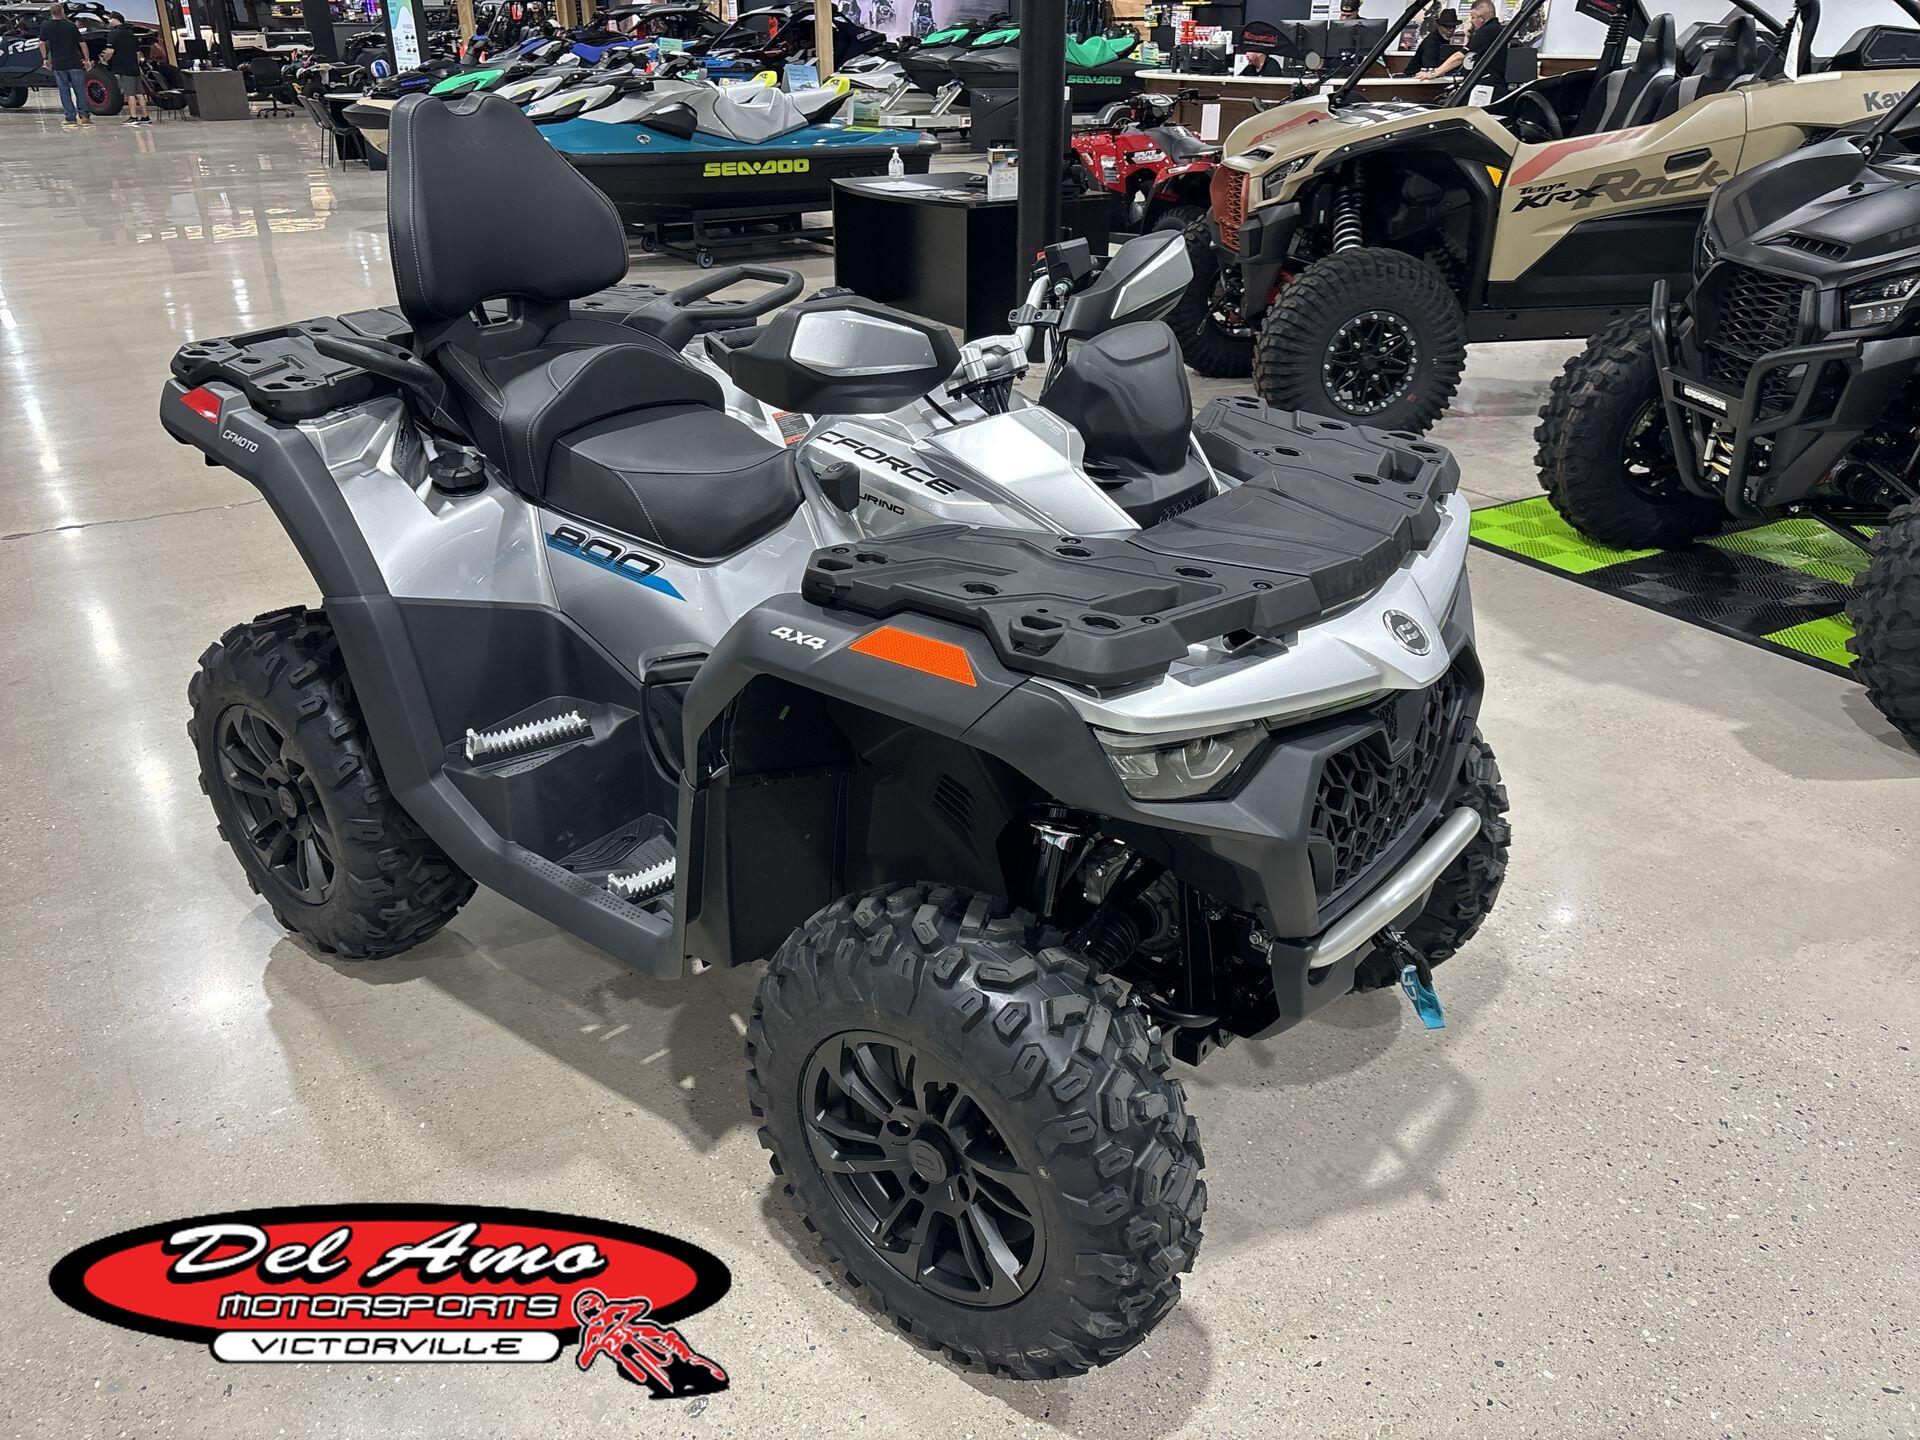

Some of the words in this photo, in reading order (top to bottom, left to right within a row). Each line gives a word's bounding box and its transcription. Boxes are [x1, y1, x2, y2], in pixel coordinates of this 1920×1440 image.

[8, 37, 41, 55] RS
[1511, 184, 1607, 213] KRX
[222, 429, 259, 453] CFMOTO
[816, 430, 962, 495] CFORCE
[859, 494, 905, 516] URING
